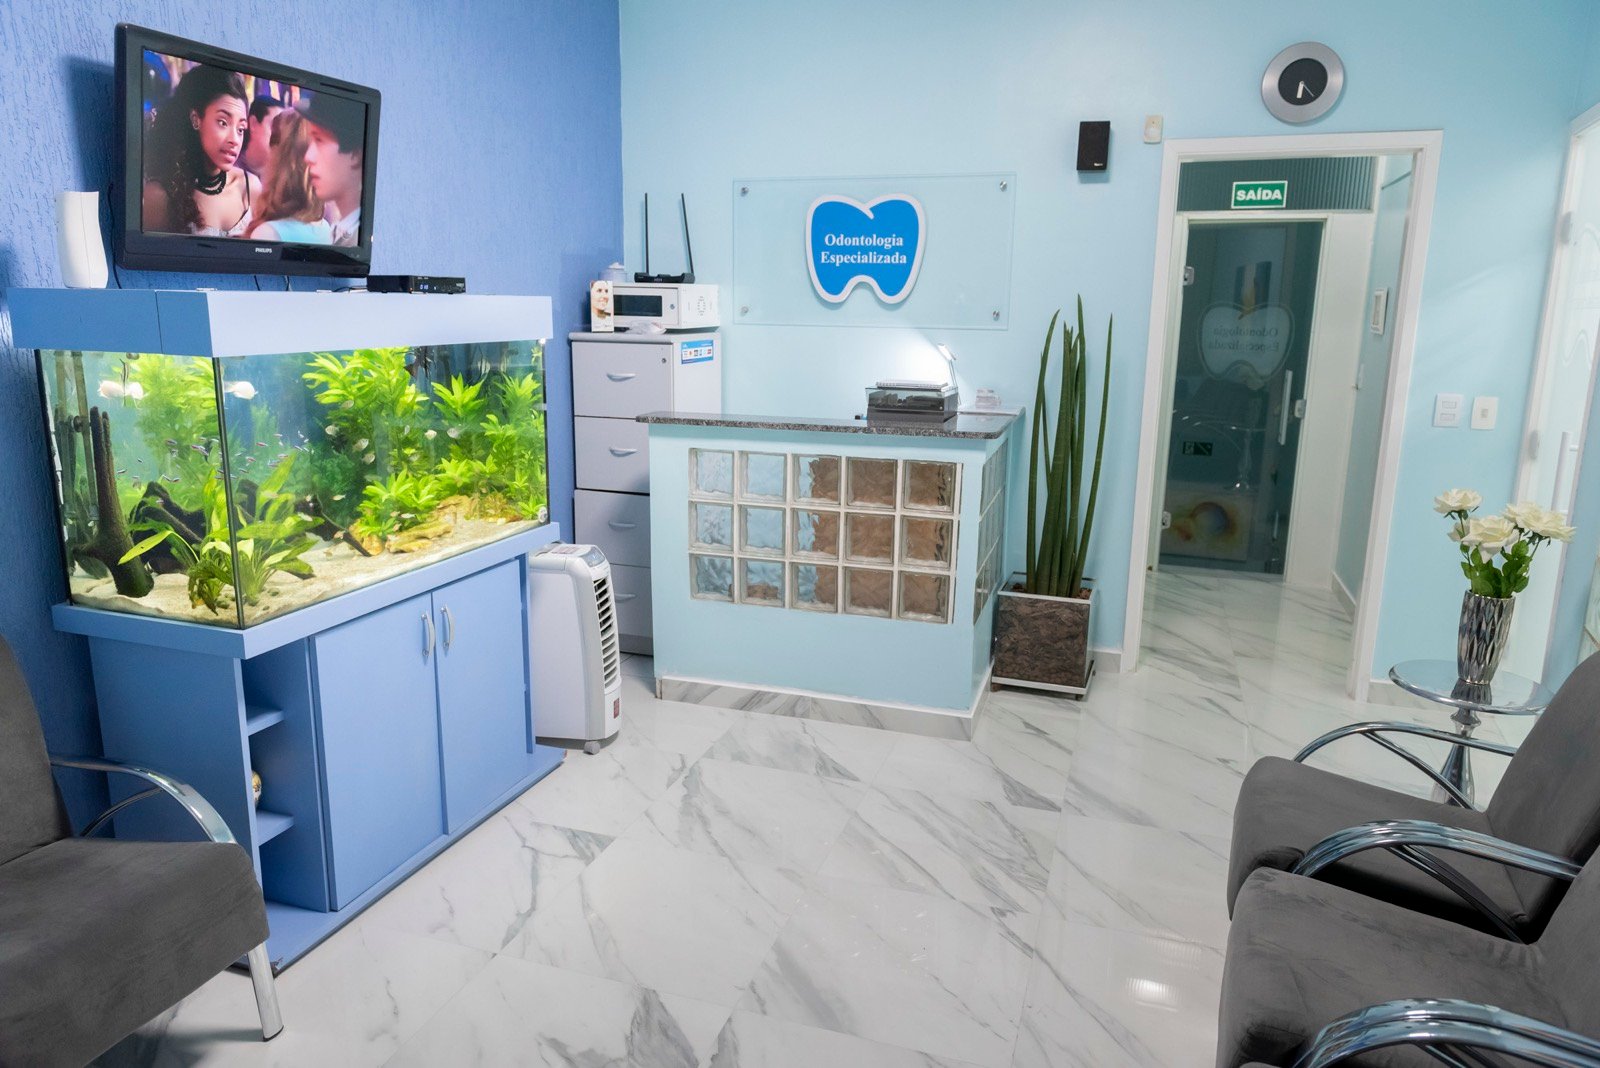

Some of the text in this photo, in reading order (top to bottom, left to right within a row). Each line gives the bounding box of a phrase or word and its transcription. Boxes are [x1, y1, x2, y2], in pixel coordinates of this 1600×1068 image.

[1236, 187, 1282, 201] SAÍDA
[824, 233, 904, 250] Odontologia
[820, 251, 907, 267] Especializada
